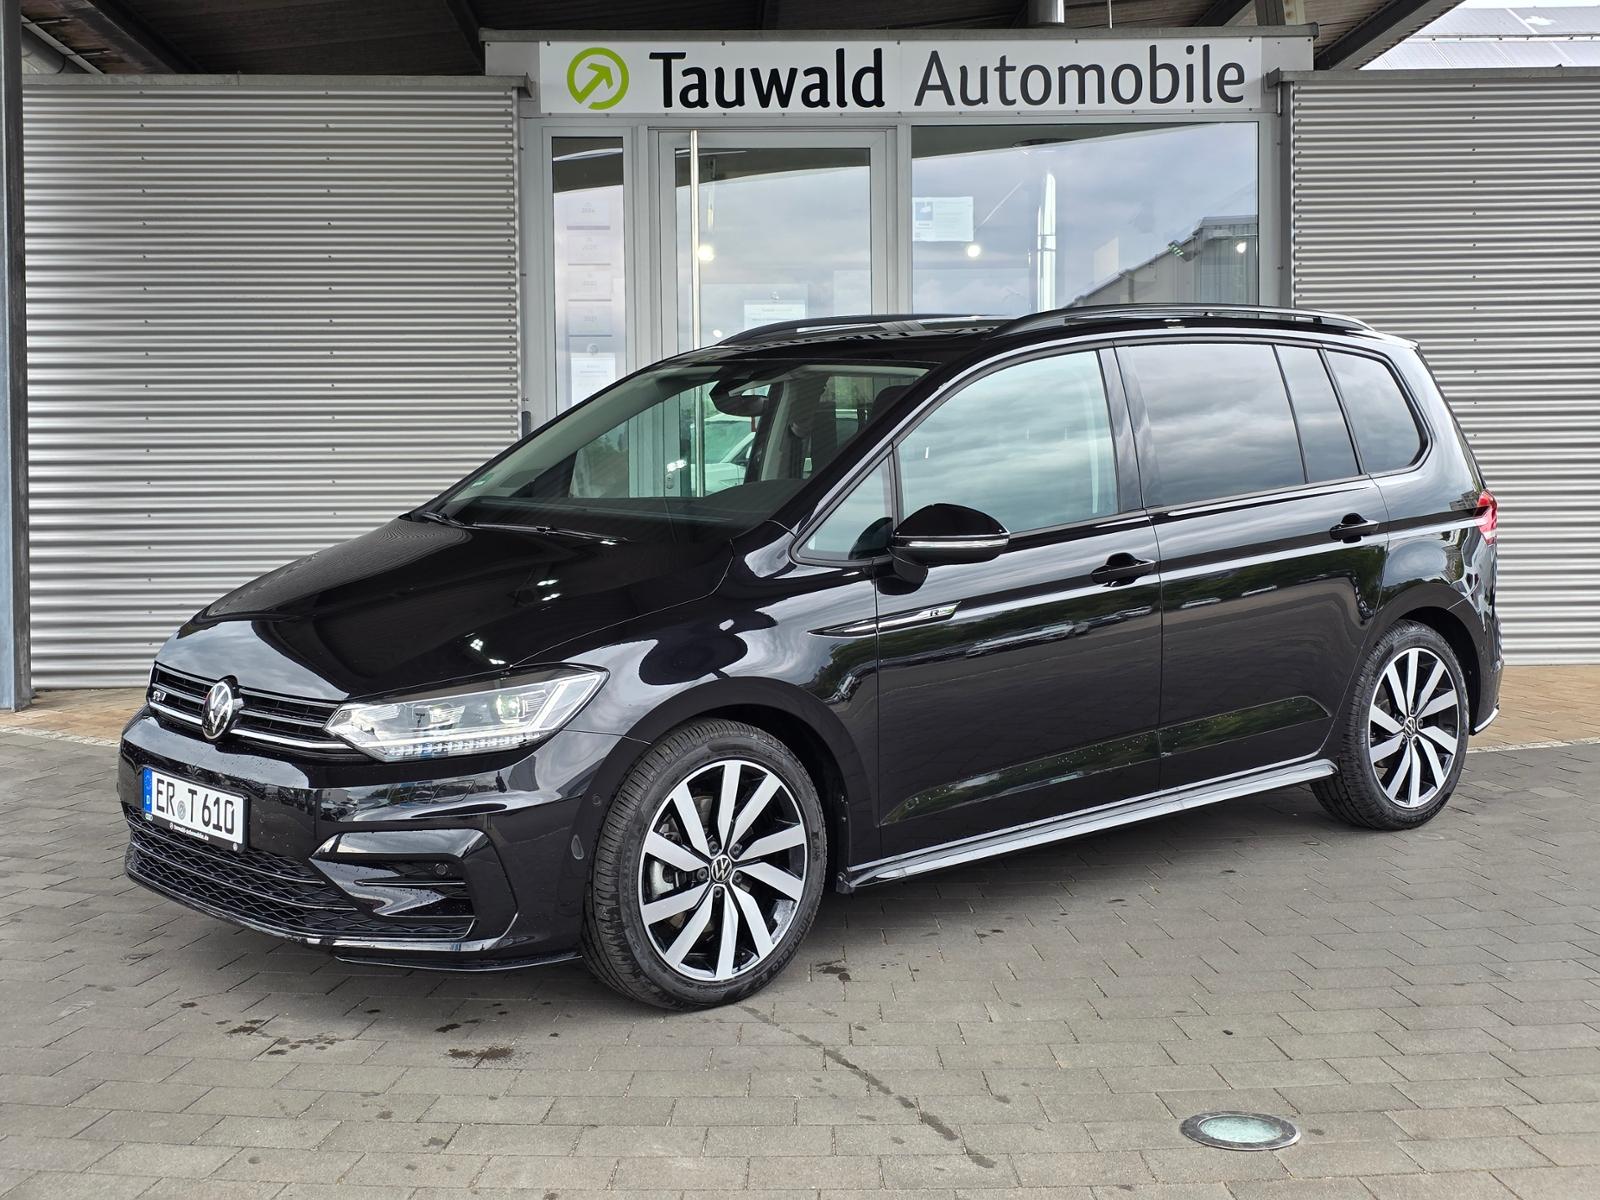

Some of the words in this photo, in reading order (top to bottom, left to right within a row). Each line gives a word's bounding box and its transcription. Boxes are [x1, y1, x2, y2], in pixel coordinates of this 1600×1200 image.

[648, 47, 886, 109] Tauwald
[913, 44, 1246, 107] Automobile
[156, 778, 176, 817] ER
[187, 788, 198, 823] T
[201, 793, 235, 835] 610
